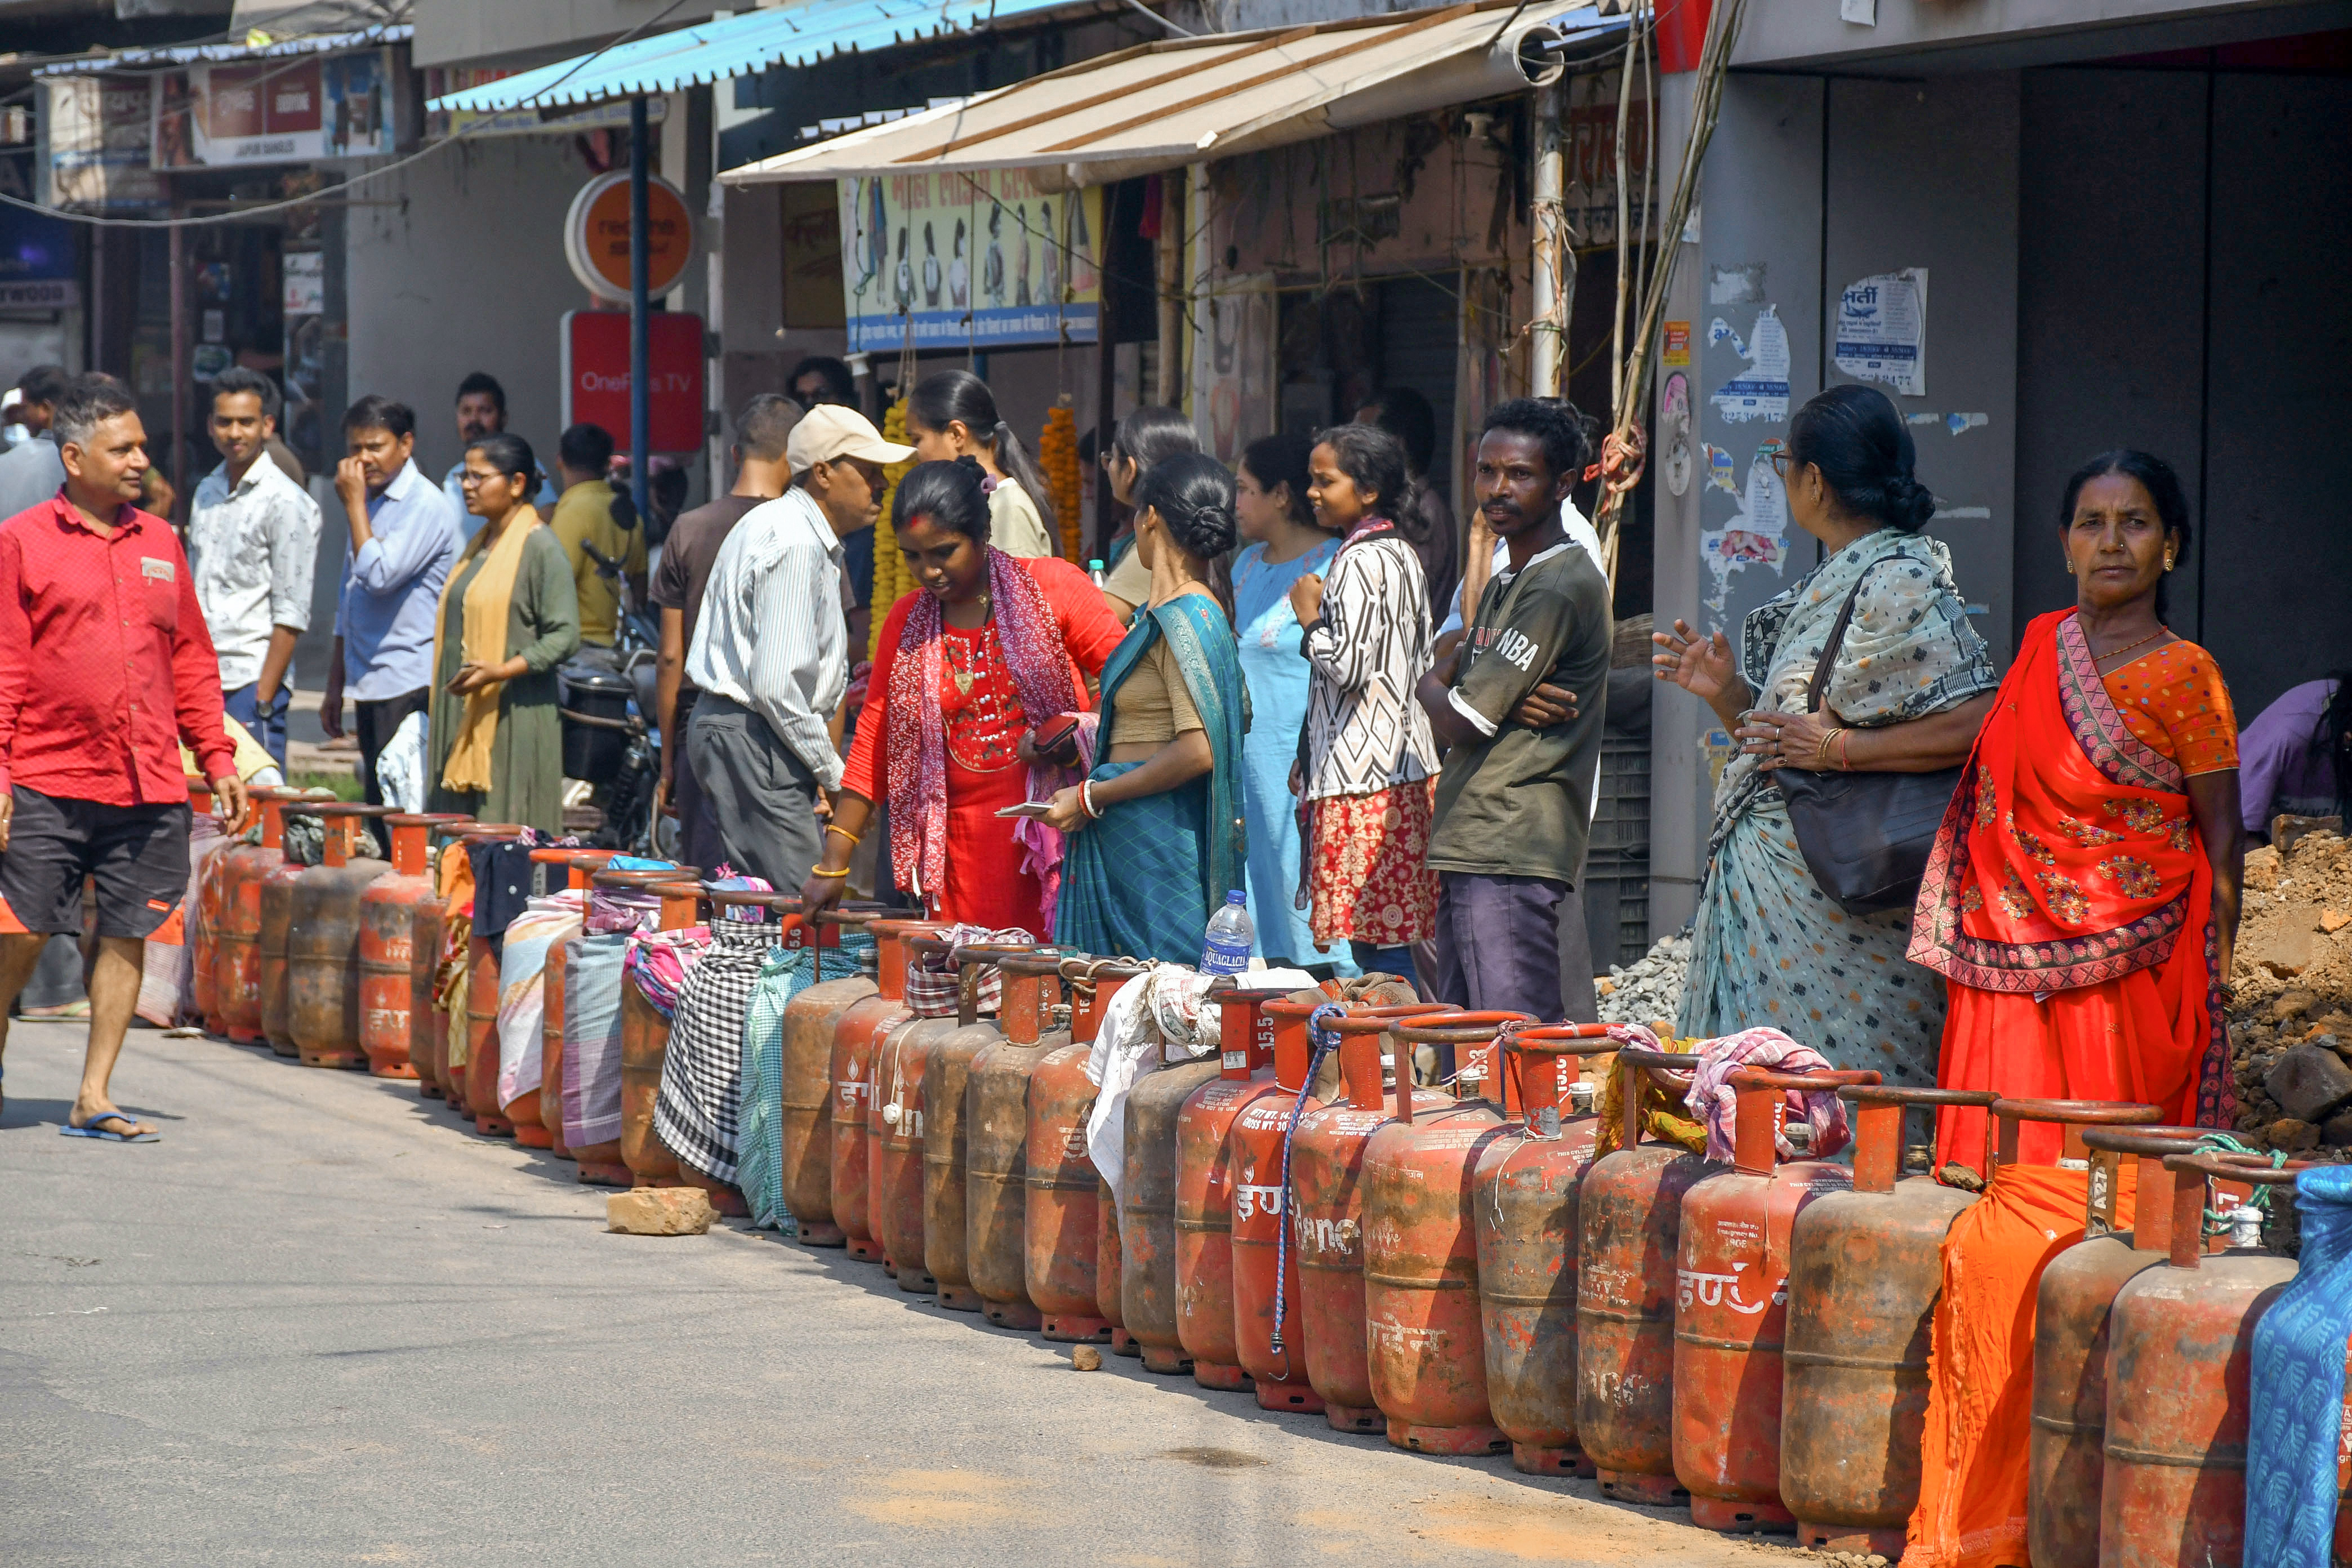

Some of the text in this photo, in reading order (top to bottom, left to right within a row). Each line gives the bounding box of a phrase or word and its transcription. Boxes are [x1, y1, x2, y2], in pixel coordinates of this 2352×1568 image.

[582, 371, 692, 392] OnePs TV
[1496, 627, 1539, 672] NBA
[1257, 1017, 1275, 1050] 15.5
[1242, 1117, 1262, 1130] GROSS
[1261, 1121, 1275, 1131] WT.
[1280, 1112, 1291, 1120] 14.
[2094, 1170, 2108, 1209] A27
[1717, 1228, 1748, 1238] Emergency
